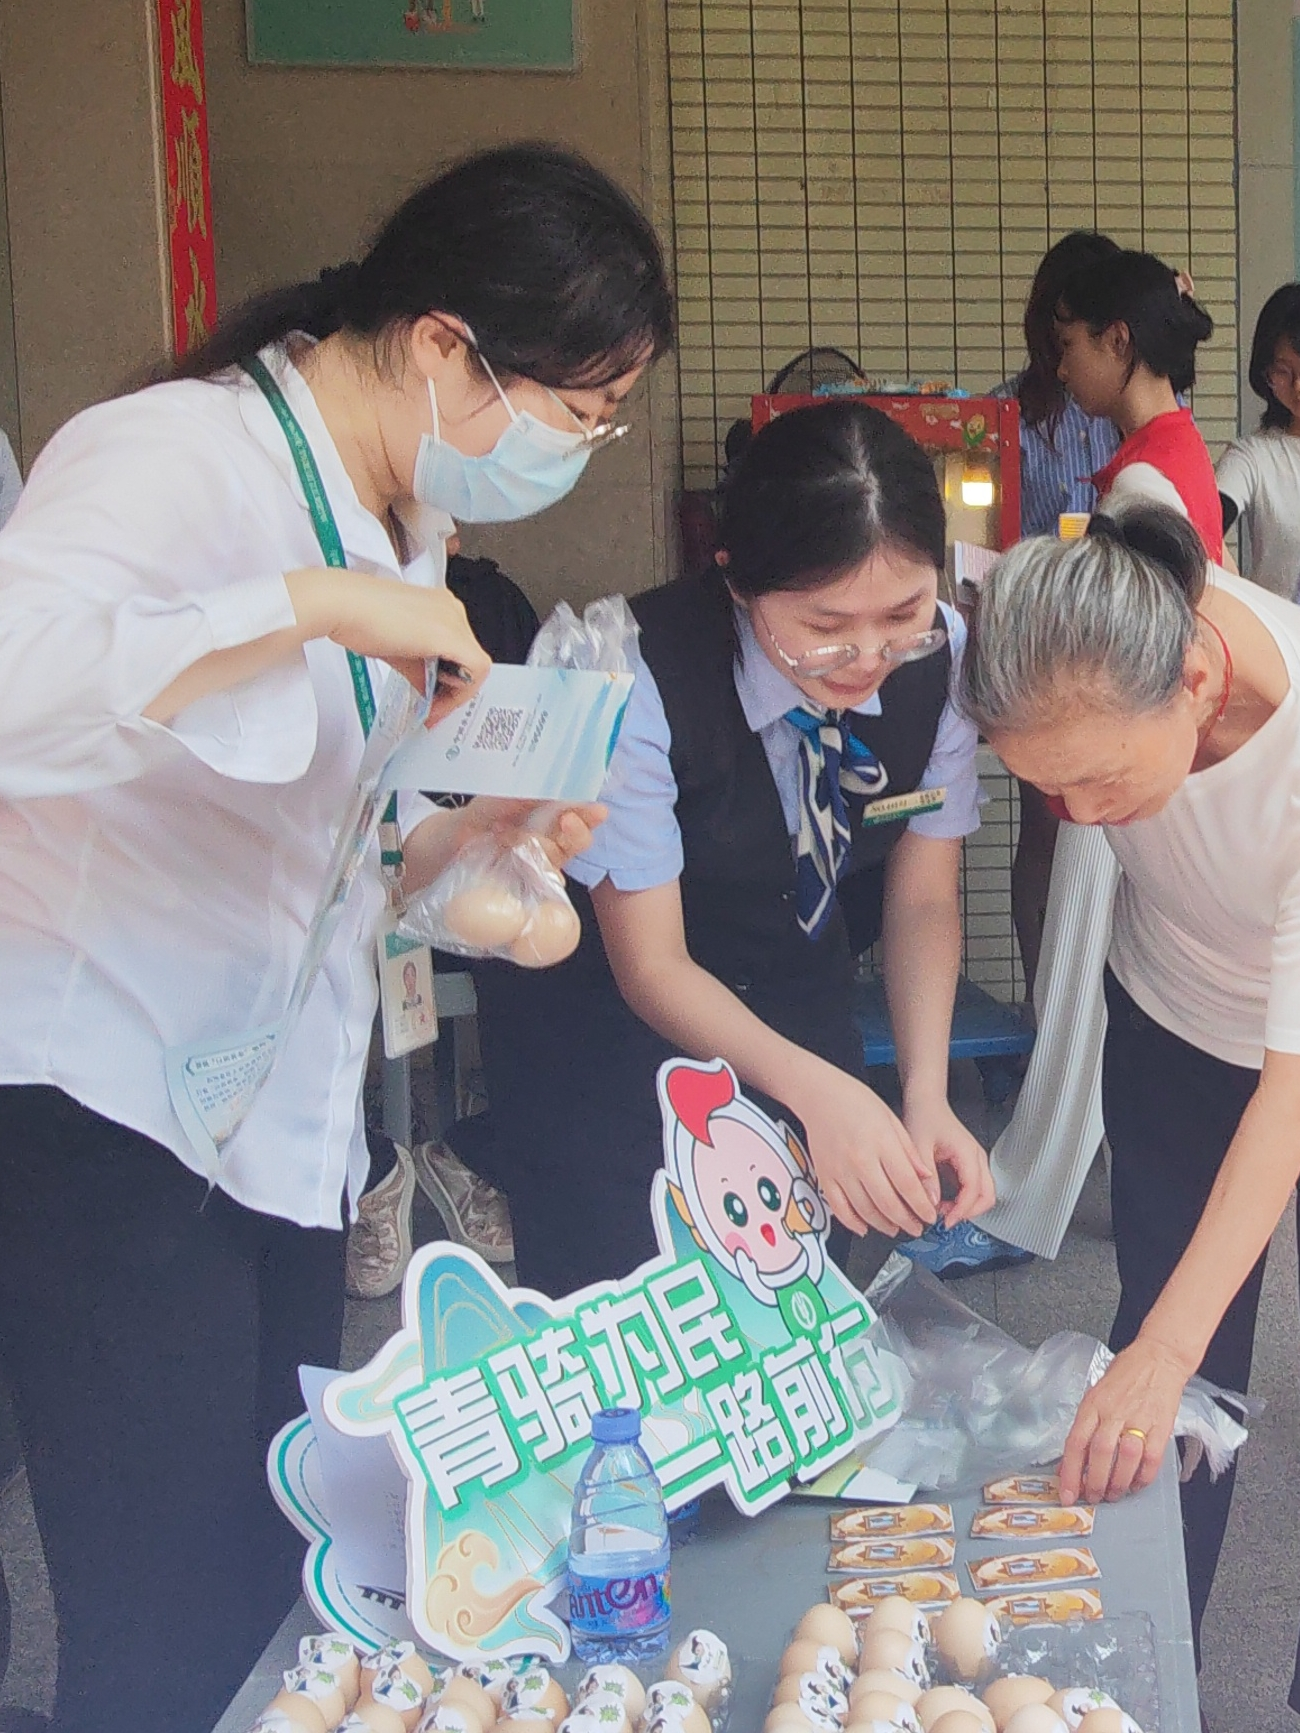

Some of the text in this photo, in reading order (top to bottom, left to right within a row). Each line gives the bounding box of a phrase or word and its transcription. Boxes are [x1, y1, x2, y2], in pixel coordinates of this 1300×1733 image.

[398, 1269, 745, 1508] 青骑为民
[653, 1306, 897, 1491] 一路前行
